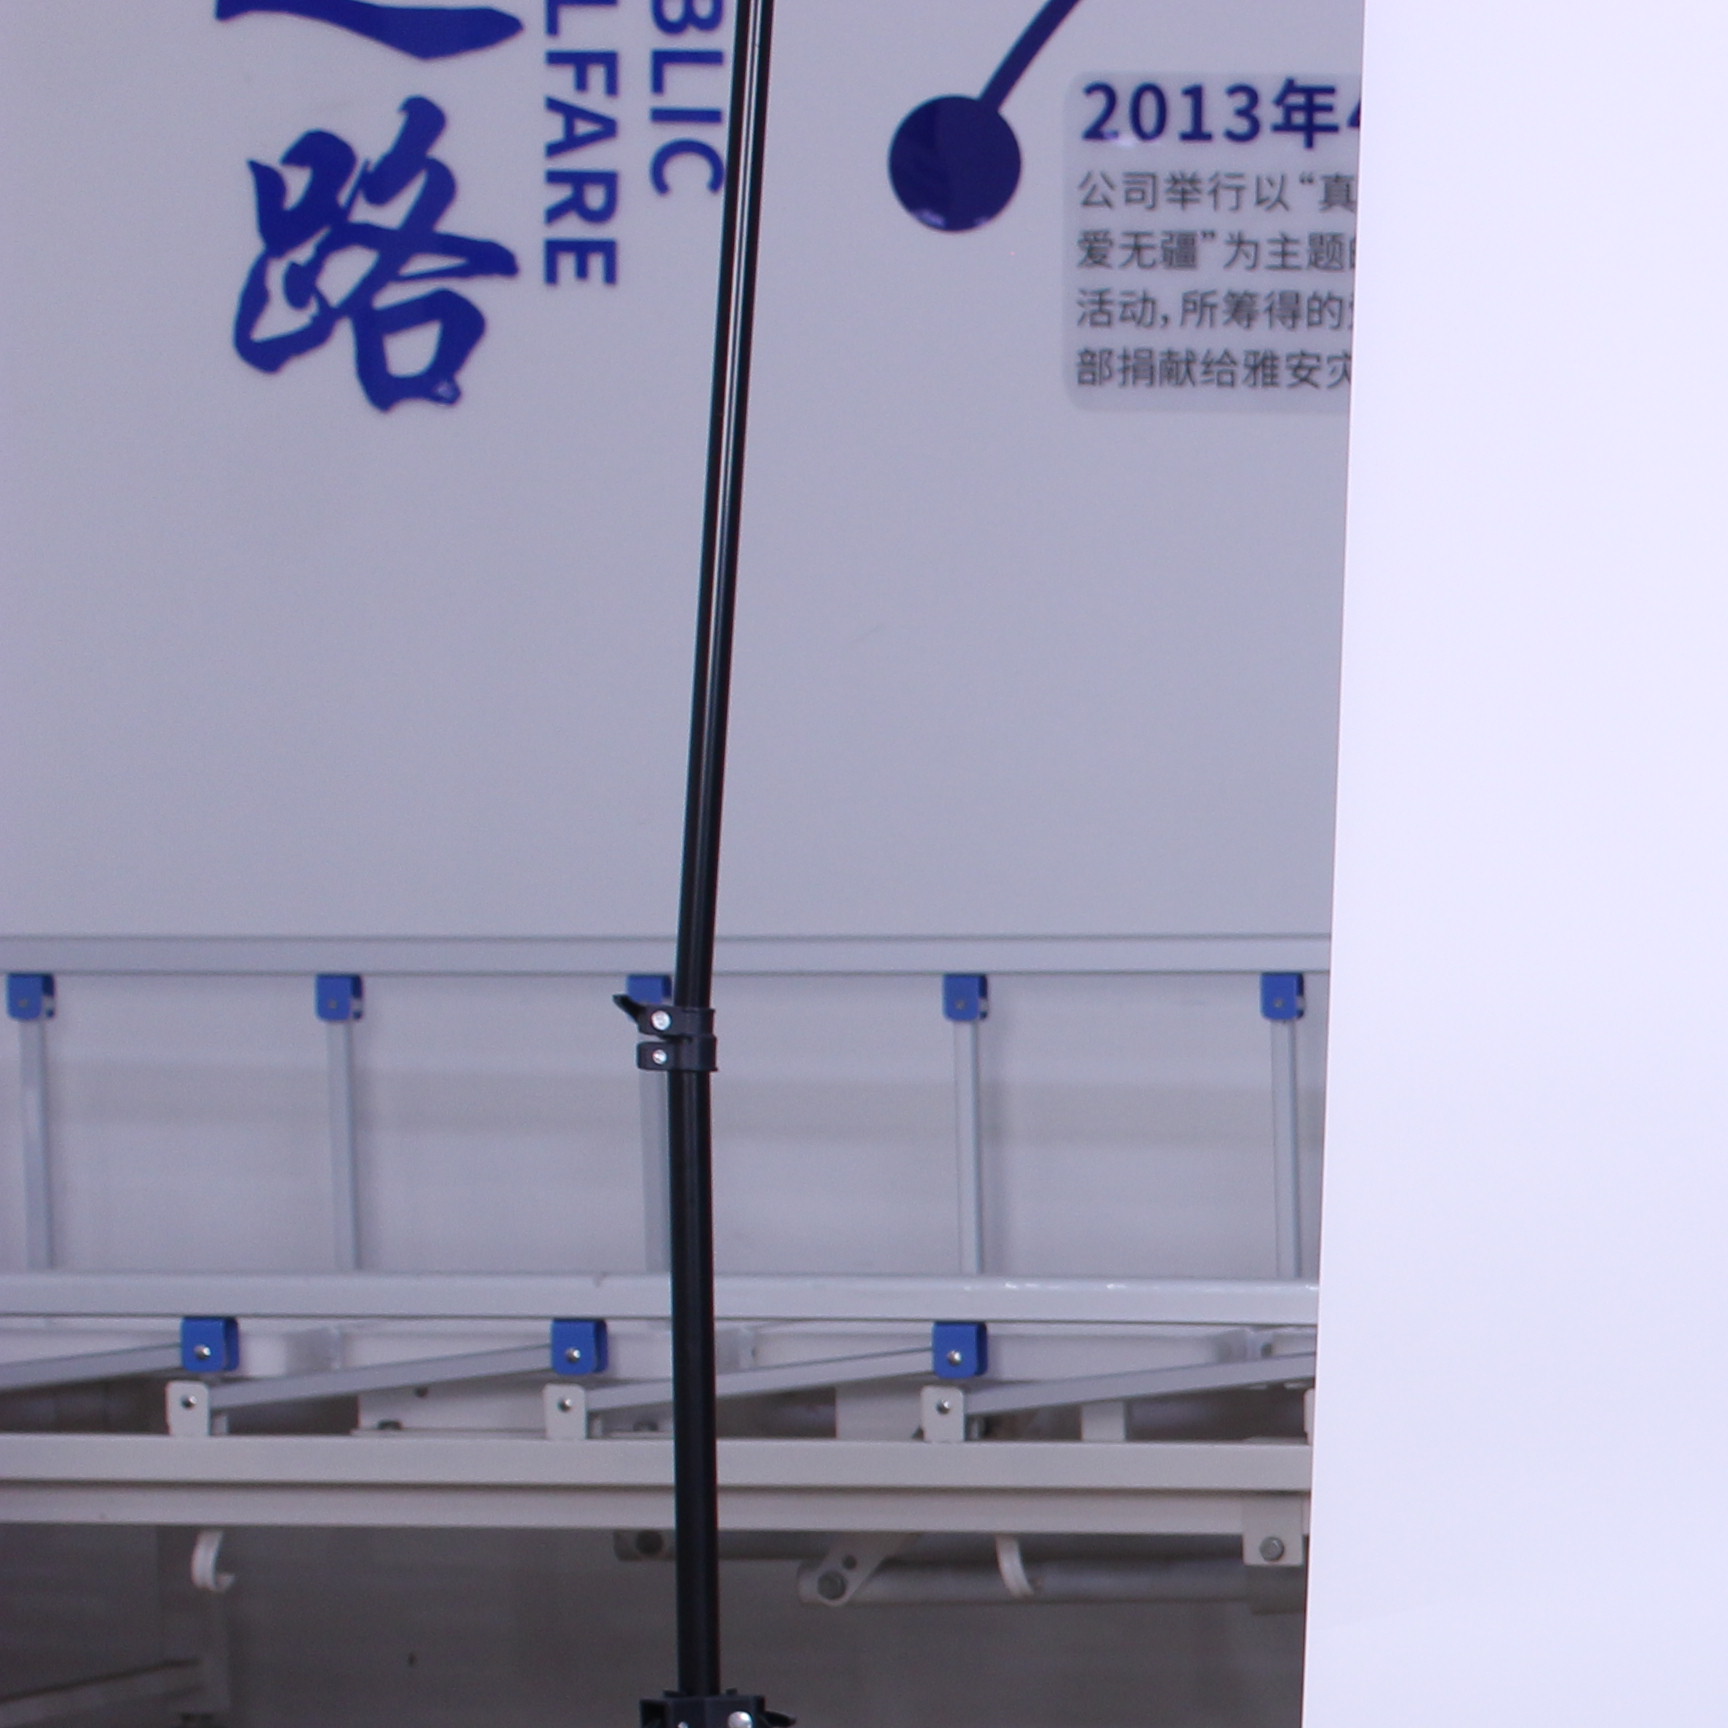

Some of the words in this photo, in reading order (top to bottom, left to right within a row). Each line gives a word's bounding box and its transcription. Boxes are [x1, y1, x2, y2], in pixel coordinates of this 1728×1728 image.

[1076, 229, 1354, 272] 爱无疆”为主题
[1076, 288, 1352, 331] 活动，所筹得的
